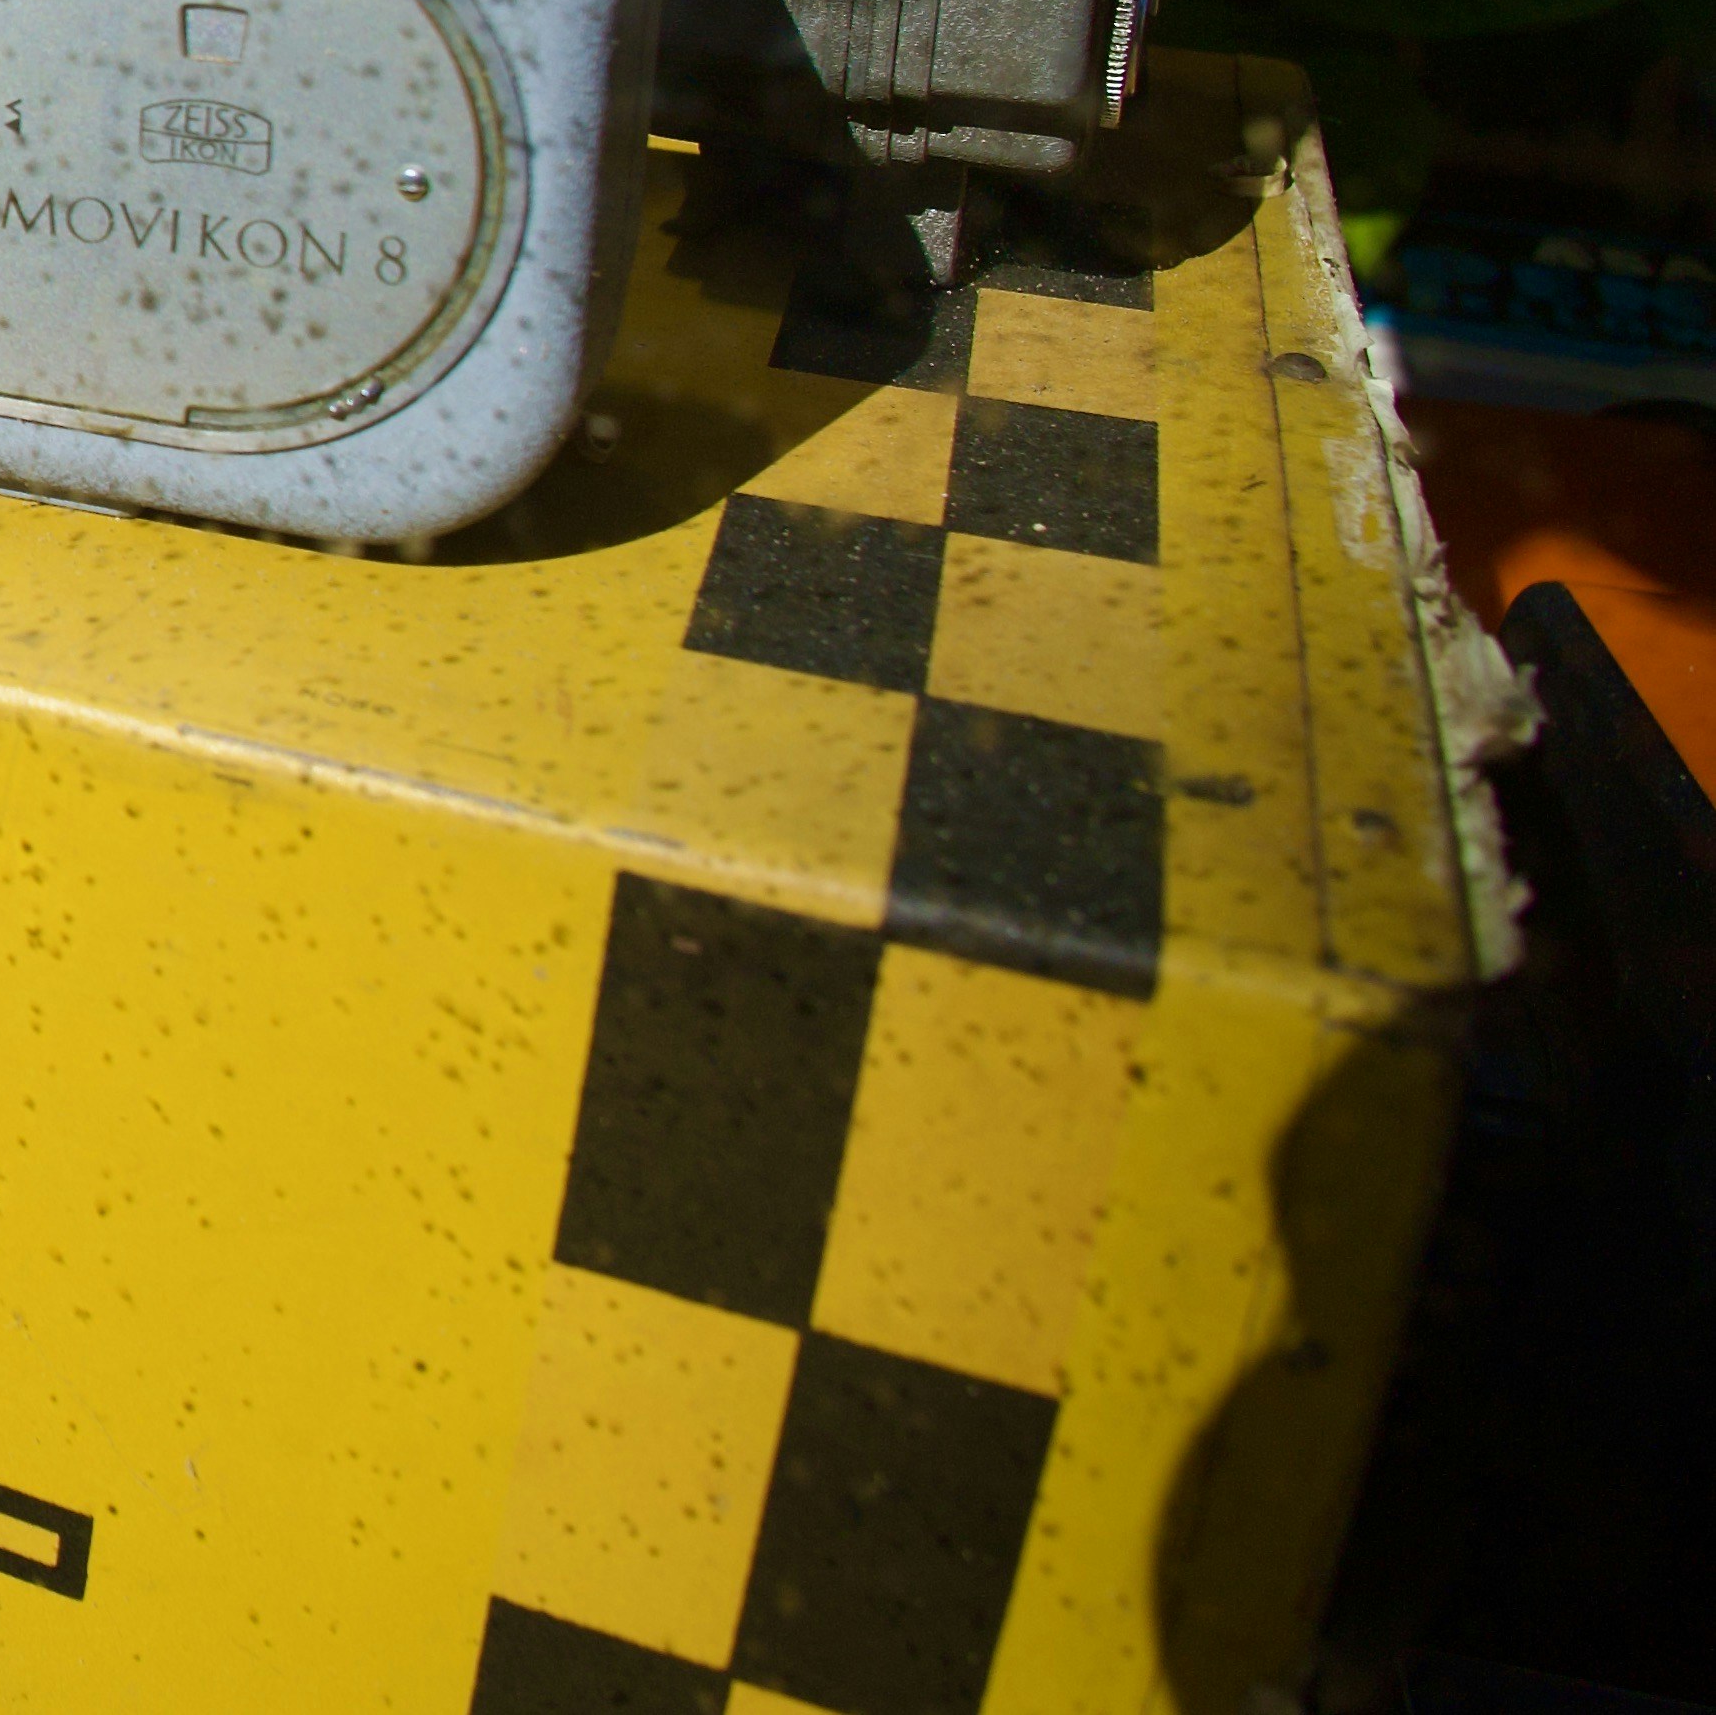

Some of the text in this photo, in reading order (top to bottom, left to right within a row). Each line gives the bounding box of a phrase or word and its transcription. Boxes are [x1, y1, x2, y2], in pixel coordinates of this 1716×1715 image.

[161, 104, 248, 139] ZEISS
[170, 137, 238, 165] IKON
[1, 187, 407, 286] MOVIKON 8
